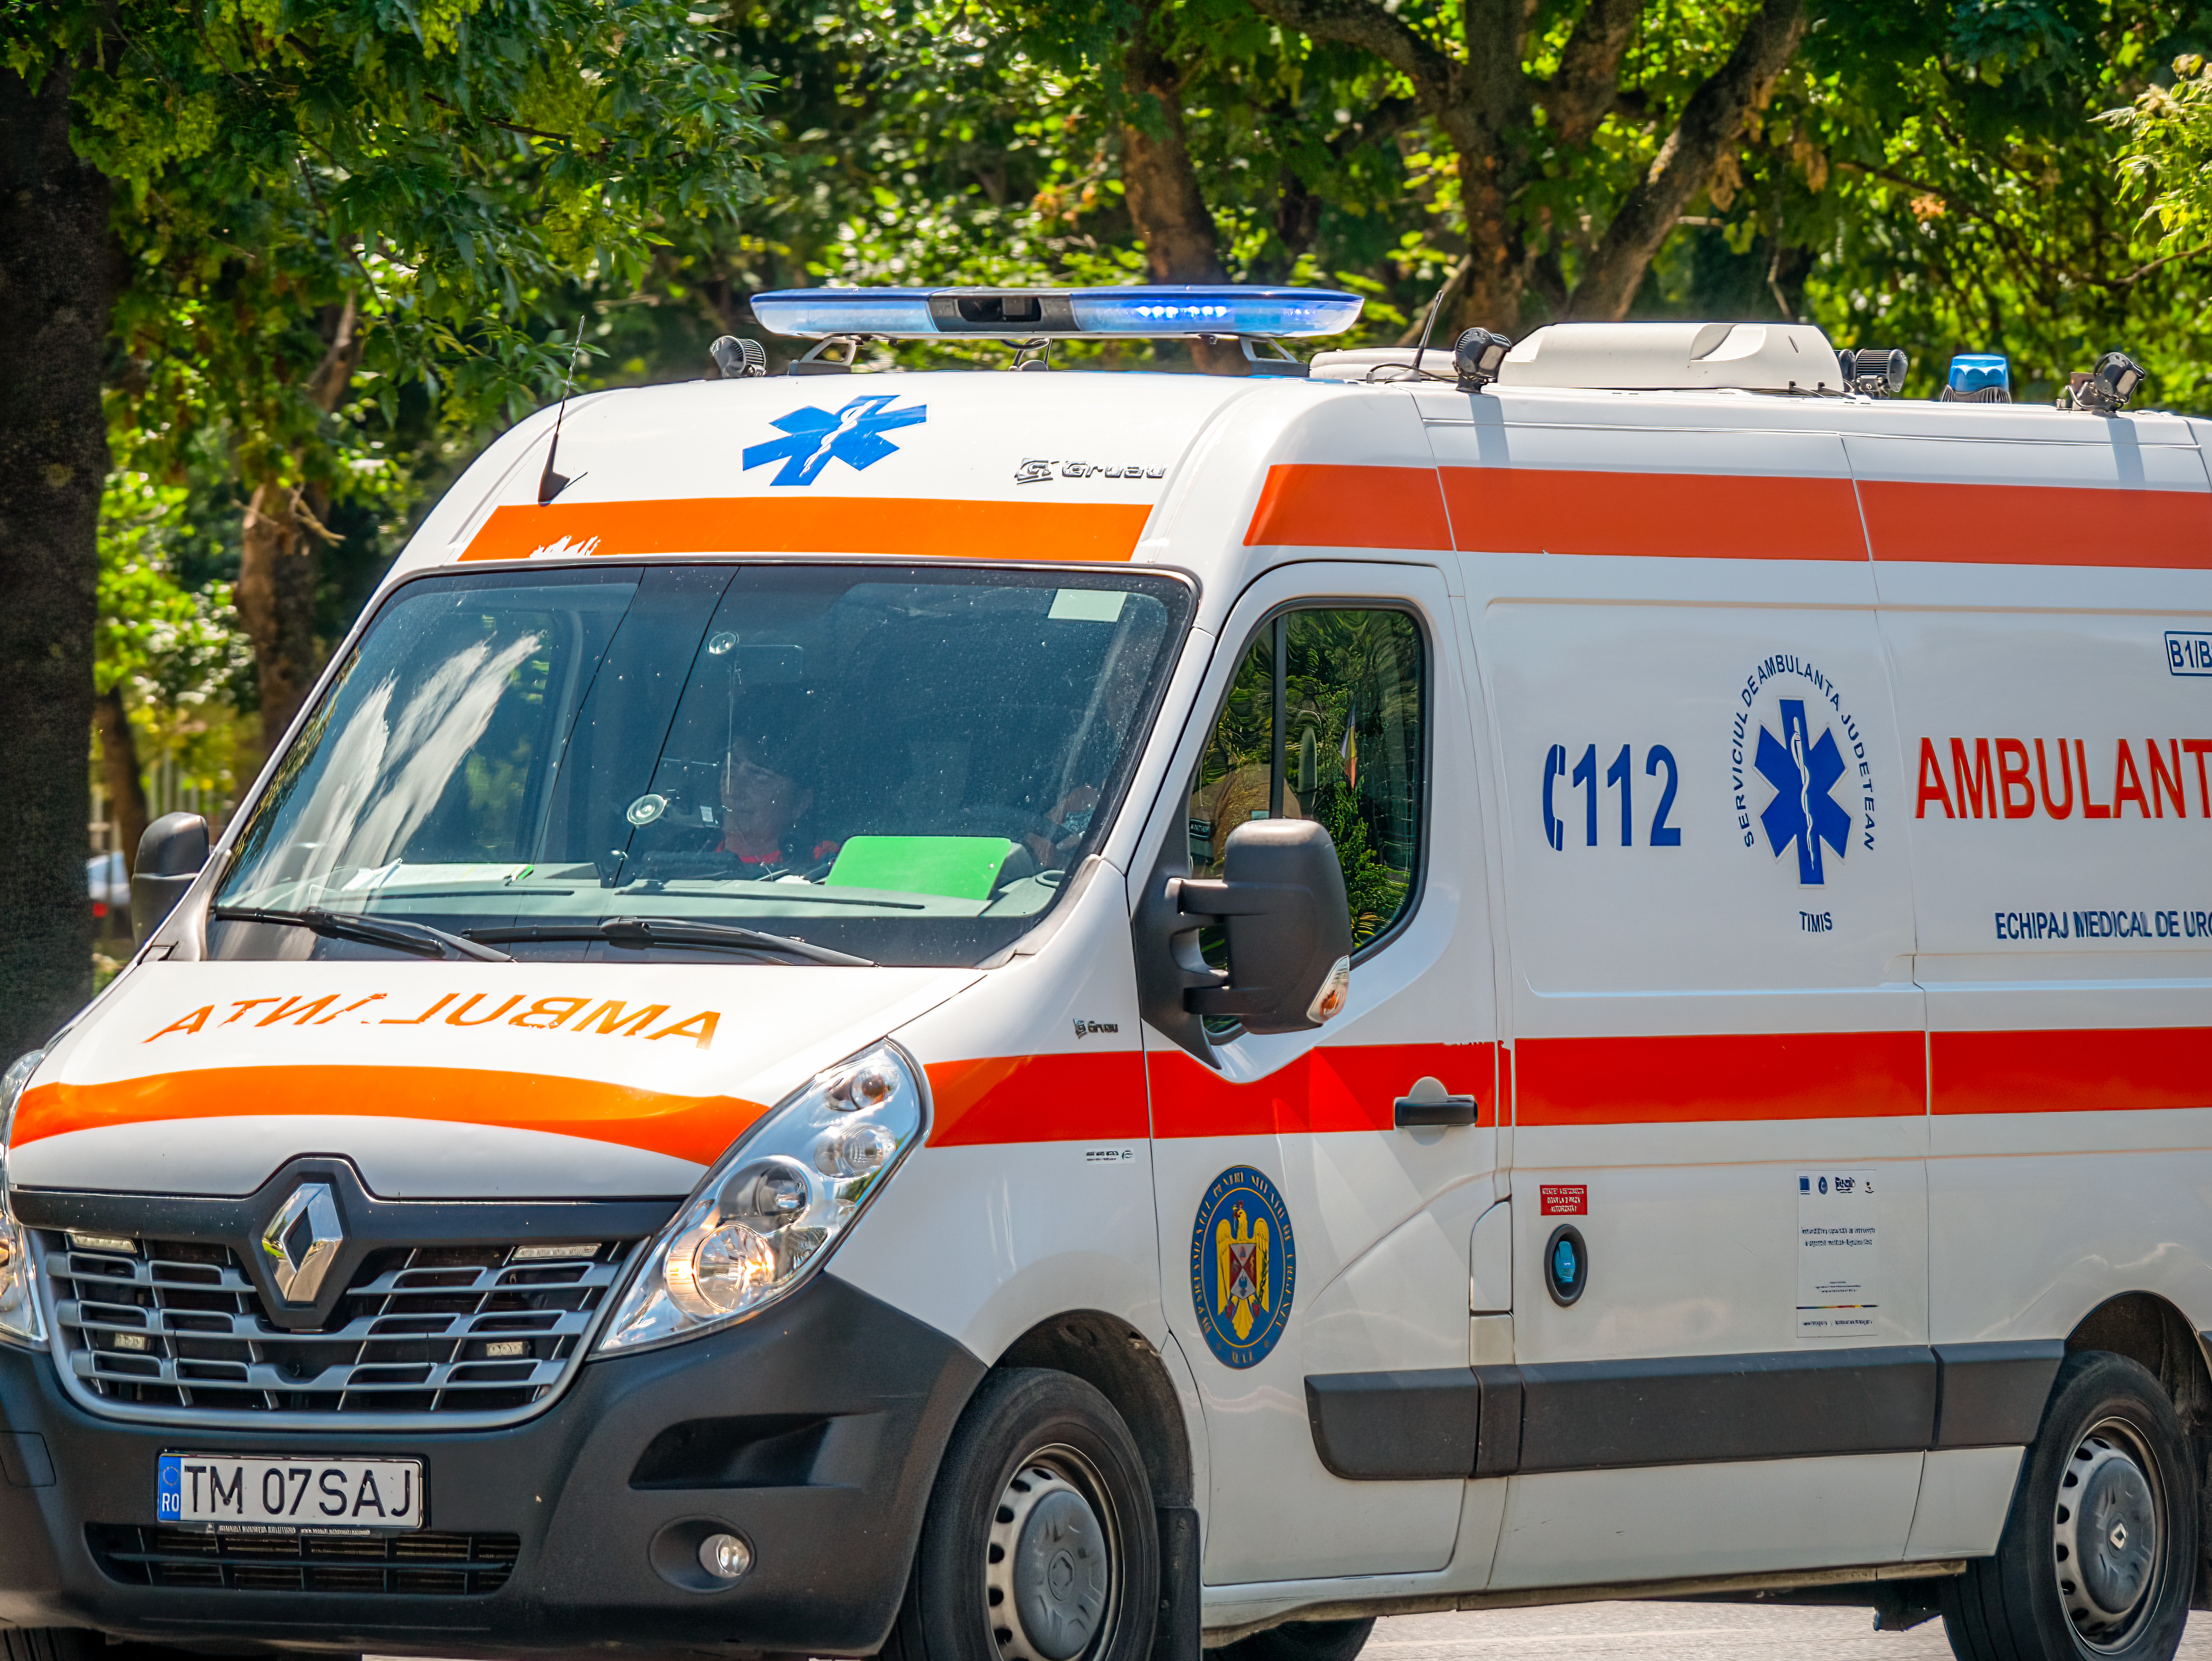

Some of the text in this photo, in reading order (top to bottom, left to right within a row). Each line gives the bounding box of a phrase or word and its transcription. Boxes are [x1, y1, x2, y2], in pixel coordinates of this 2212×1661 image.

[1062, 461, 1166, 479] Gruau
[2169, 640, 2212, 668] B1/B
[1732, 655, 1875, 850] SERVICIUL DE AMBULANTA JUDETEAN
[1915, 738, 2212, 819] AMBULANT
[1573, 744, 1681, 846] 112
[1799, 911, 1832, 933] TIMIS
[1995, 912, 2069, 939] ECHIPAJ
[2073, 910, 2153, 938] MEDICAL
[2155, 910, 2180, 937] DE
[162, 1492, 180, 1512] RO
[184, 1465, 243, 1514] TM
